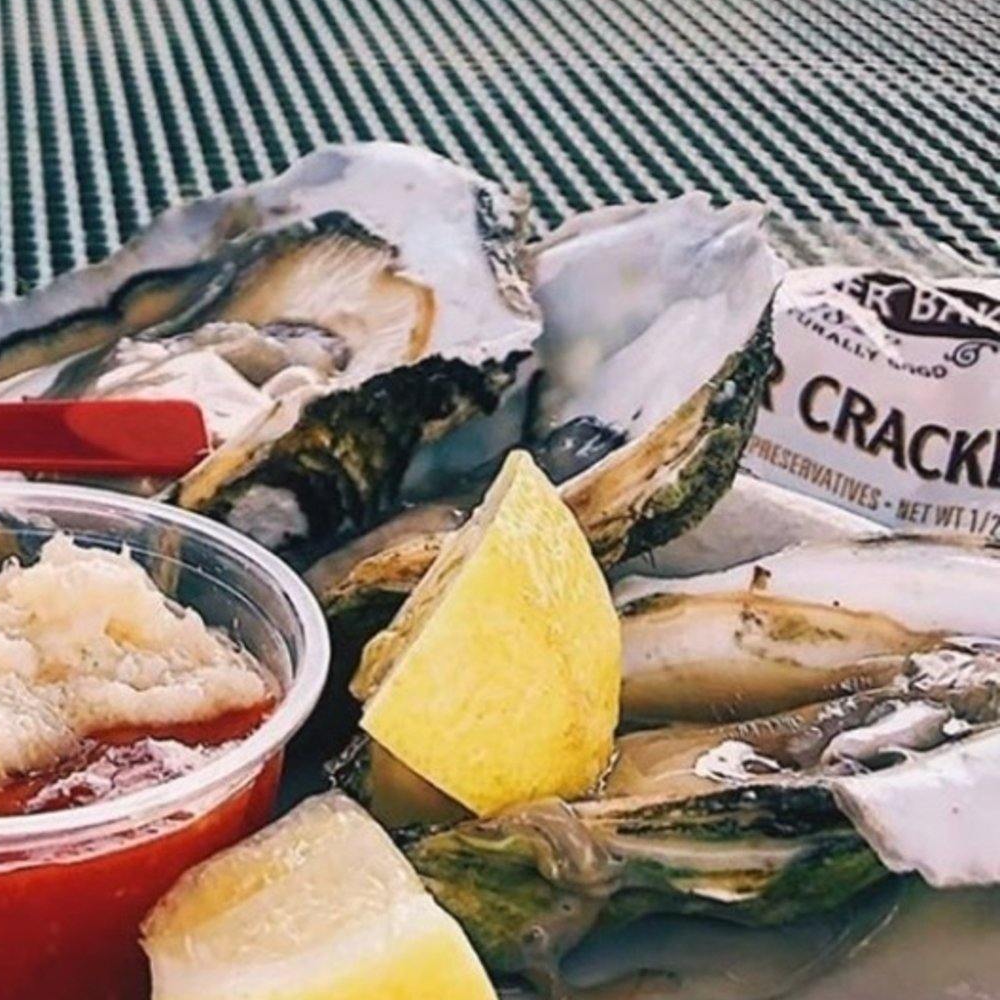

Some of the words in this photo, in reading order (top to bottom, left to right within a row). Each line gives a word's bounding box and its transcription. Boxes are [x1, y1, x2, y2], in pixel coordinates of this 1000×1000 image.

[751, 434, 882, 512] PRESERVATIVES
[895, 498, 934, 523] NET
[933, 505, 965, 528] WT
